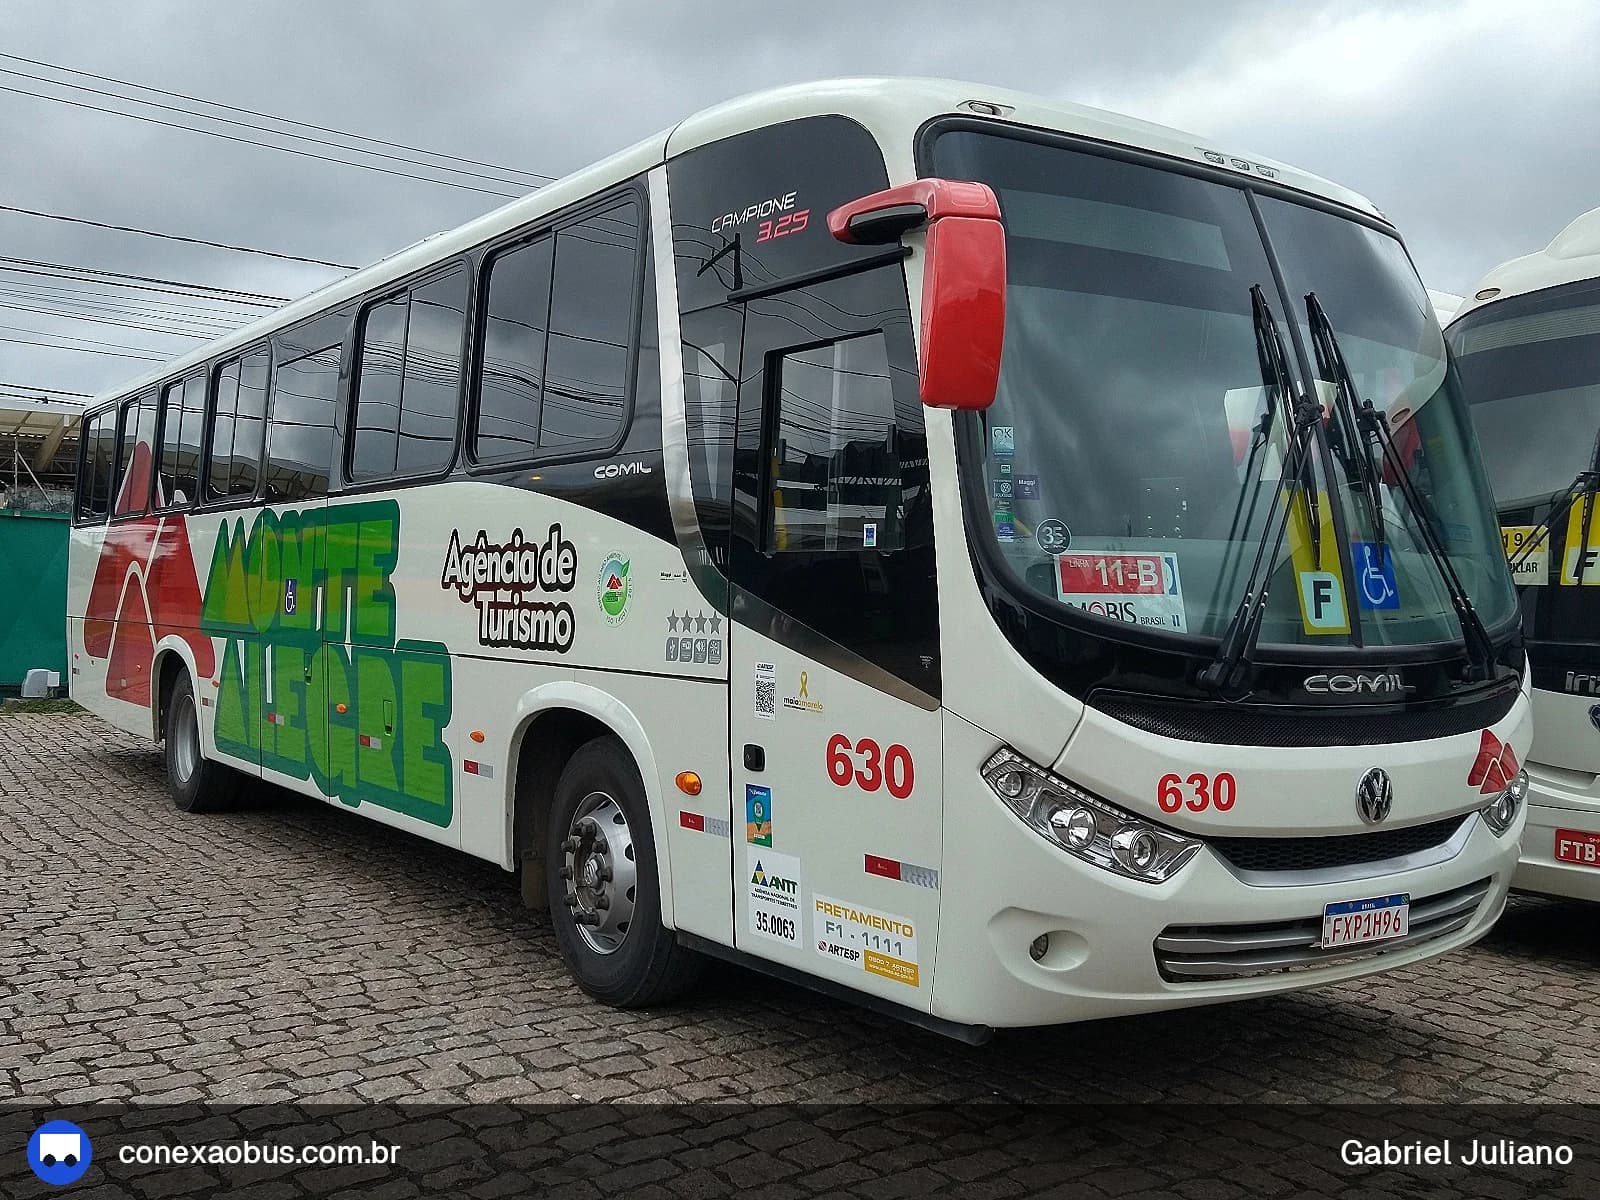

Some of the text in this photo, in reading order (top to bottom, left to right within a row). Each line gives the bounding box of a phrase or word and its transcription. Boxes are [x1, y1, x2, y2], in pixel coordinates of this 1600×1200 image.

[711, 191, 797, 233] CAMPIONE
[756, 209, 810, 243] 3.25
[593, 461, 652, 479] COMIL
[1041, 526, 1063, 545] 35
[202, 508, 397, 638] MONTE
[443, 530, 536, 598] Agência
[540, 525, 575, 588] de
[1069, 558, 1090, 568] LINHA
[1095, 559, 1159, 586] 11-B
[1312, 580, 1332, 619] F
[477, 589, 574, 651] Turismo
[1140, 616, 1166, 626] BRASIL
[1303, 674, 1417, 693] COMIL
[215, 638, 450, 818] ALEGRE
[826, 733, 915, 799] 630
[1157, 772, 1237, 813] 630
[769, 875, 798, 894] ANTT
[756, 910, 795, 941] 35.0063
[815, 899, 914, 938] FRETAMENTO
[1332, 909, 1401, 942] FXP1H96
[825, 920, 843, 939] F1
[861, 931, 902, 956] 1111
[827, 943, 861, 961] ARTESP
